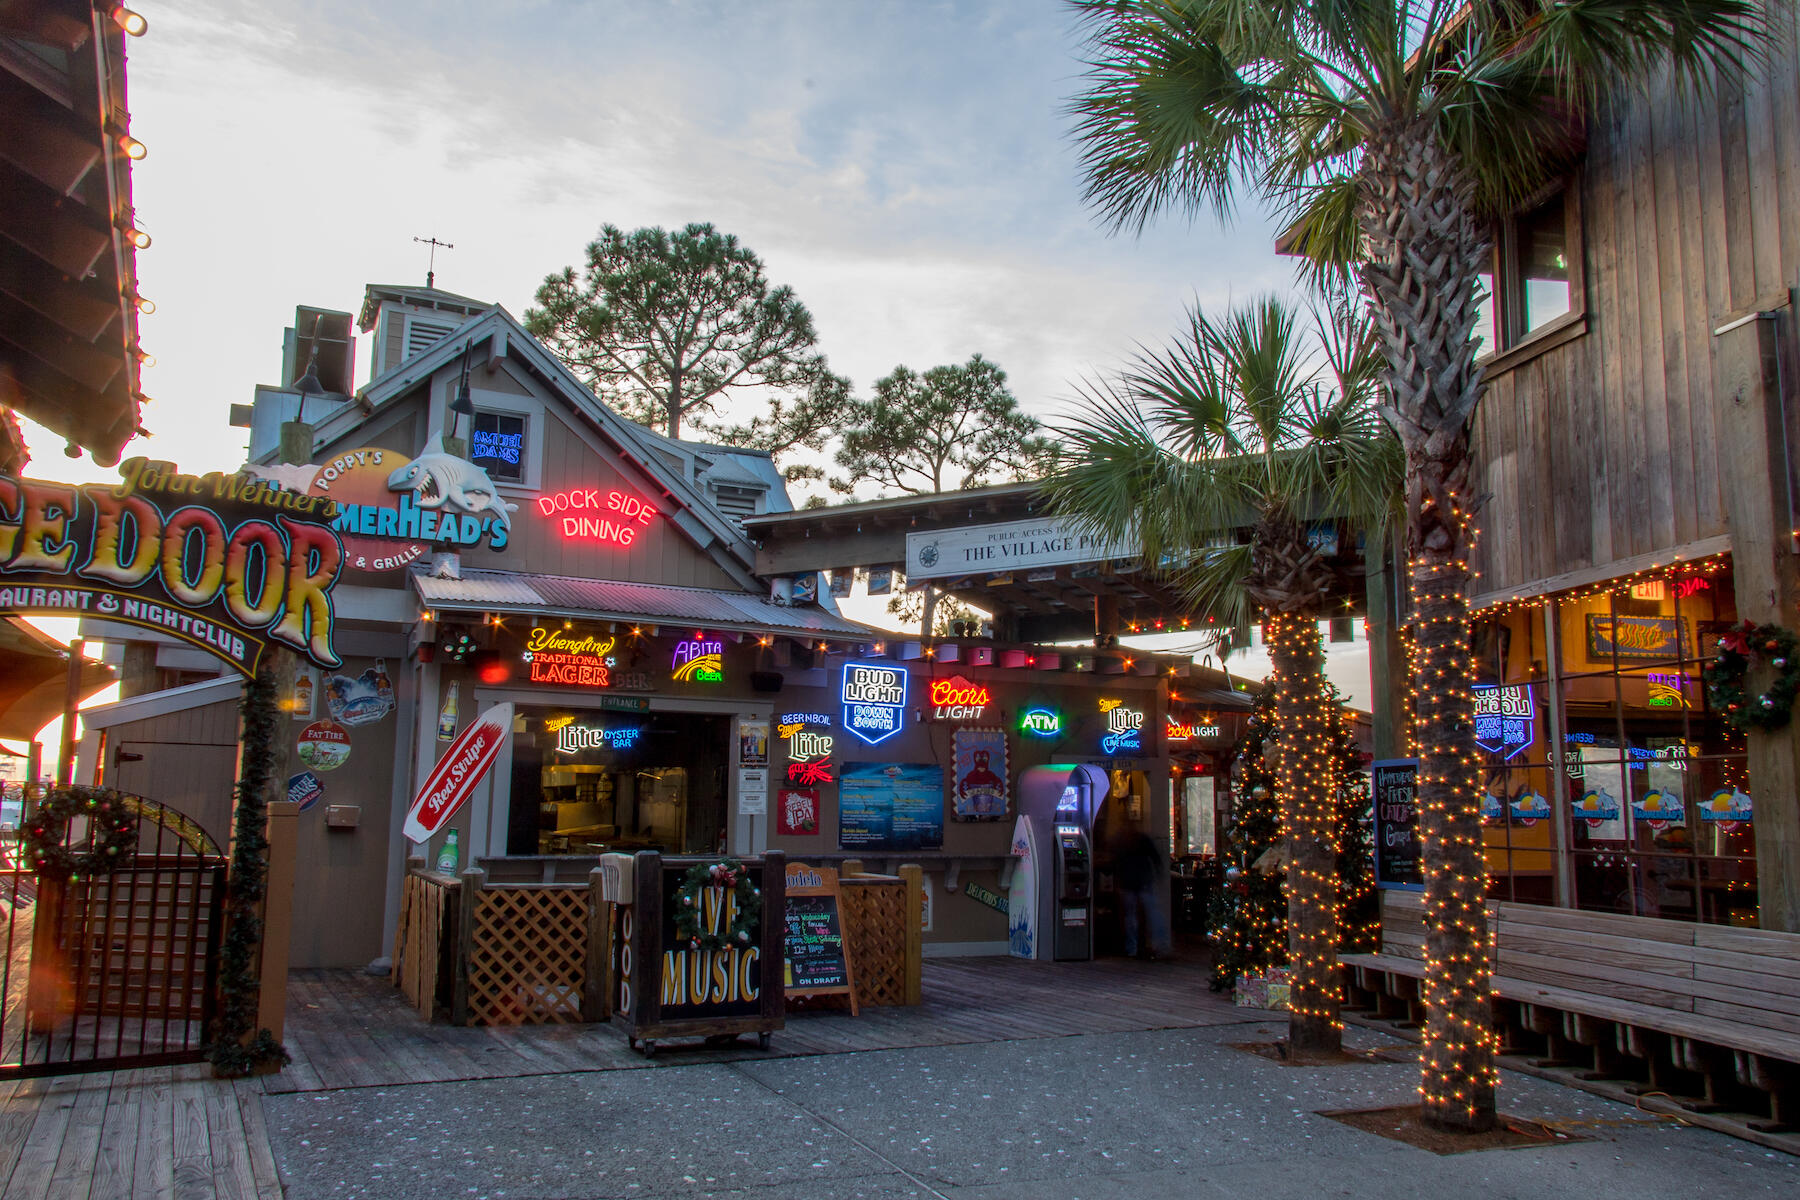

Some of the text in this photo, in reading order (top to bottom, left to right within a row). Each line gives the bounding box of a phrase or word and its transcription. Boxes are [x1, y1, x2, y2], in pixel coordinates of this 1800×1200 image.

[315, 451, 383, 491] POPPY'S
[112, 458, 338, 517] John Wehner's
[539, 490, 657, 526] DOCK SIDE
[563, 517, 635, 545] DINING
[988, 533, 1018, 542] PUBLIC
[1021, 528, 1052, 539] ACCESS
[373, 545, 422, 570] GRILLE
[963, 545, 996, 561] THE
[1001, 536, 1073, 558] VILLAGE
[76, 486, 342, 667] DOOR
[1638, 581, 1662, 598] EXIT
[97, 593, 120, 614] &
[124, 599, 246, 662] NIGHTCLUB
[527, 627, 615, 657] Yuengling
[532, 652, 605, 667] TRADITIONAL
[672, 641, 722, 670] ABITA
[530, 662, 609, 686] LAGER
[696, 669, 722, 681] BEER
[855, 669, 895, 686] BUD
[846, 684, 903, 703] LIGHT
[931, 681, 989, 705] Coors
[782, 714, 805, 725] BEER
[853, 706, 894, 719] DOWN
[936, 705, 985, 719] LIGHT
[1108, 708, 1143, 734] Lite
[853, 718, 893, 730] SOUTH
[1022, 714, 1059, 731] ATM
[1191, 726, 1219, 737] LIGHT
[307, 729, 344, 740] FAT TIRE
[556, 725, 604, 754] Lite
[603, 729, 639, 740] OYSTER
[612, 738, 632, 748] BAR
[788, 732, 833, 762] Lite
[1121, 740, 1140, 748] MUSIC
[428, 734, 486, 814] Red Stripe
[787, 799, 813, 811] REBEL
[792, 809, 814, 824] IPA
[660, 946, 760, 1006] MUSIC
[814, 976, 840, 984] DRAFT
